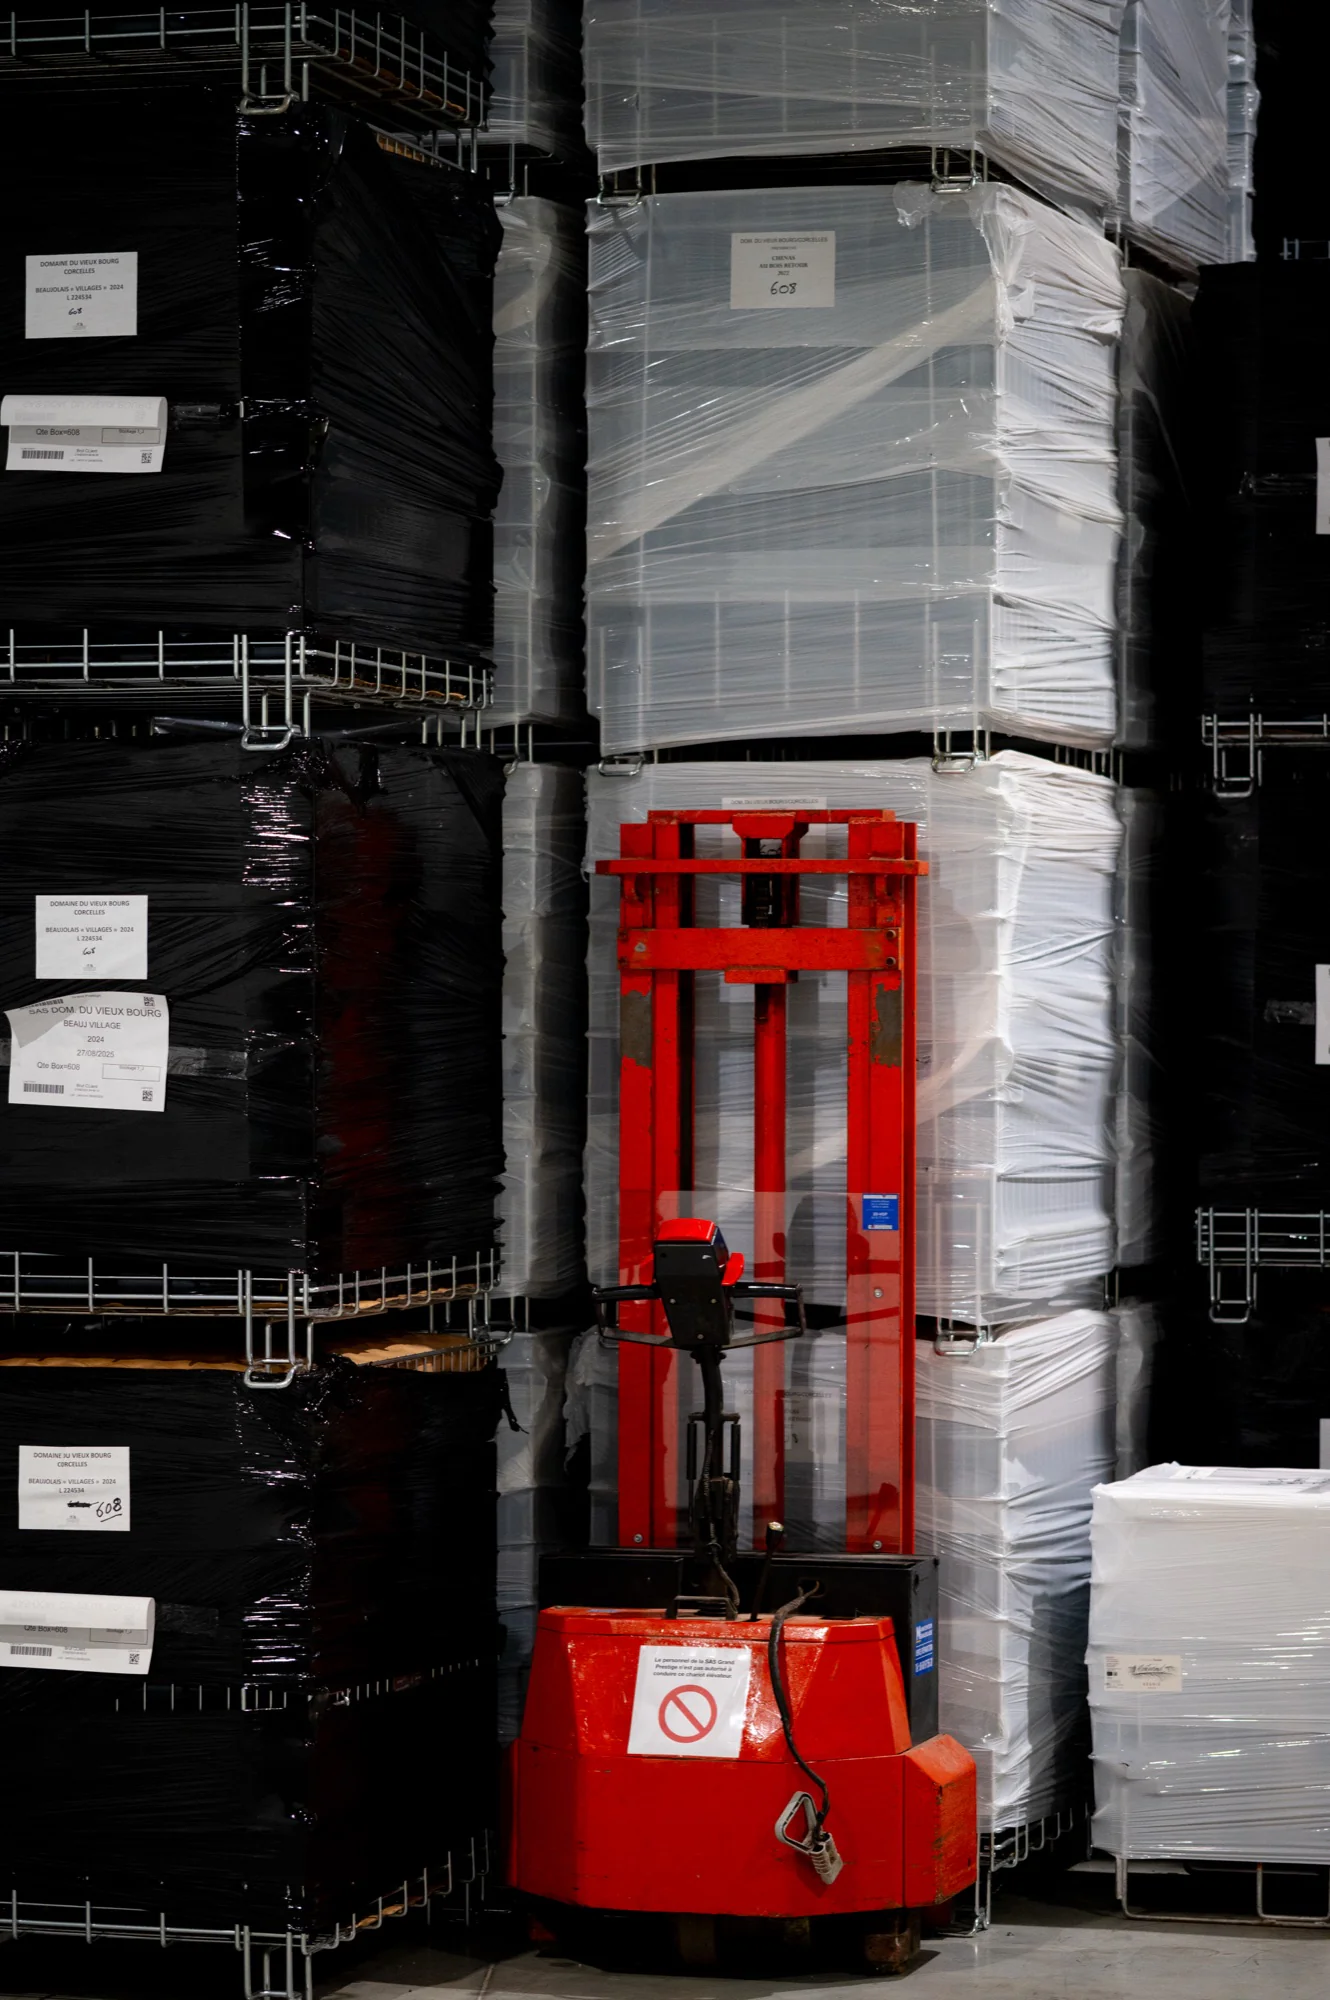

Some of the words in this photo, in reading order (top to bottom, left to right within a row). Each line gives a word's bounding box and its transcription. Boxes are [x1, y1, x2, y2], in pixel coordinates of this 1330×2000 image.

[770, 281, 797, 295] 608
[29, 1006, 49, 1015] SAS
[51, 1006, 77, 1014] DOM.
[79, 1006, 92, 1015] DU
[95, 1007, 124, 1016] VIEUX
[126, 1009, 162, 1017] BOURG
[63, 1020, 87, 1028] BEAUJ
[89, 1021, 121, 1029] VILLAGE
[77, 1049, 114, 1058] 27/08/2025
[96, 1497, 122, 1517] 608
